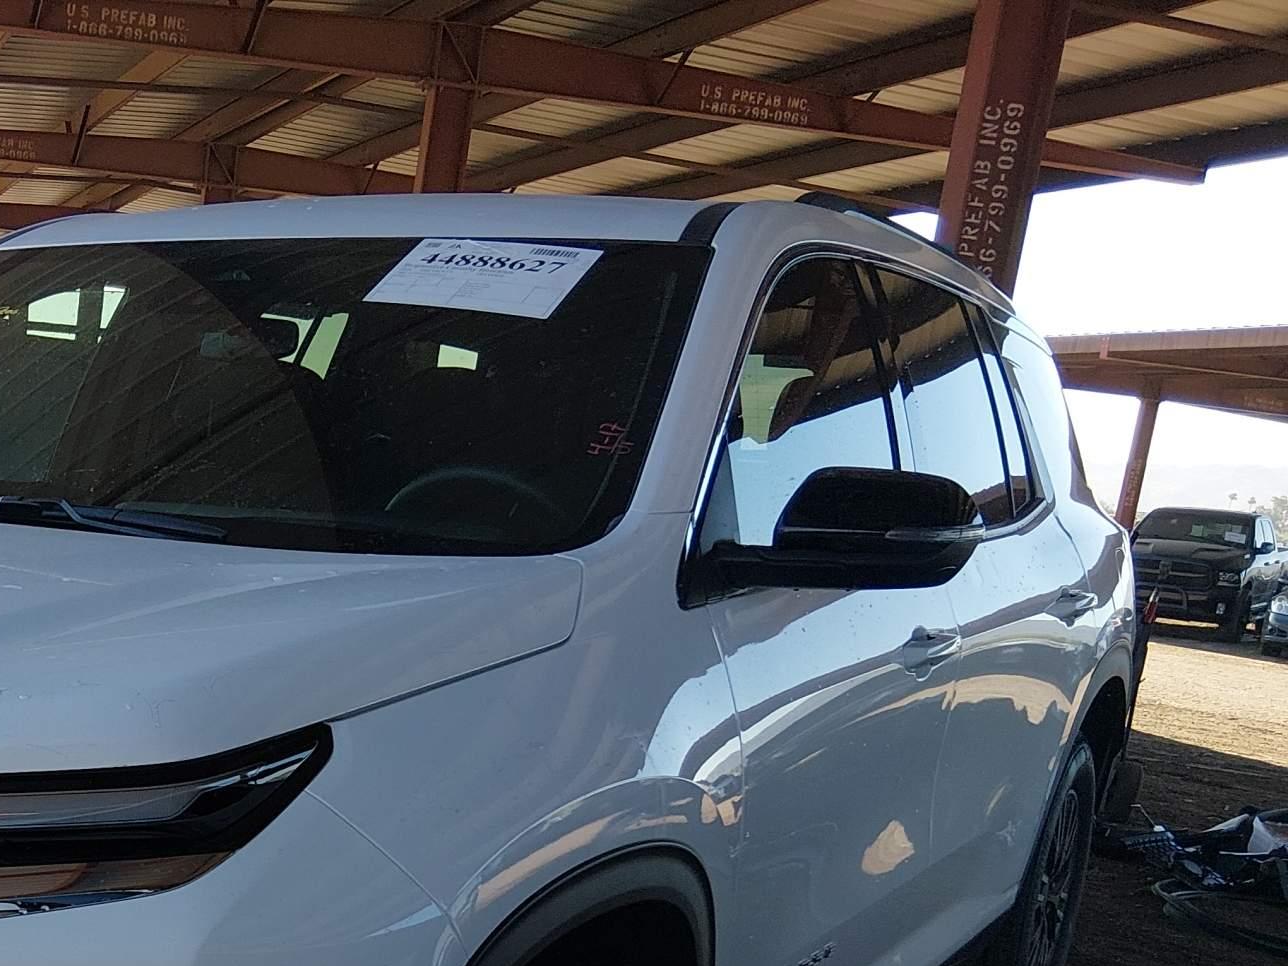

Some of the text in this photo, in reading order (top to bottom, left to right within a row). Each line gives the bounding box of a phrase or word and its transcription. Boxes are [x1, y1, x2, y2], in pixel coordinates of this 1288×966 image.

[101, 7, 157, 27] PREFAB
[732, 88, 781, 107] PREFAB
[959, 98, 1004, 257] PREFAB INC.
[421, 251, 568, 274] 44888627
